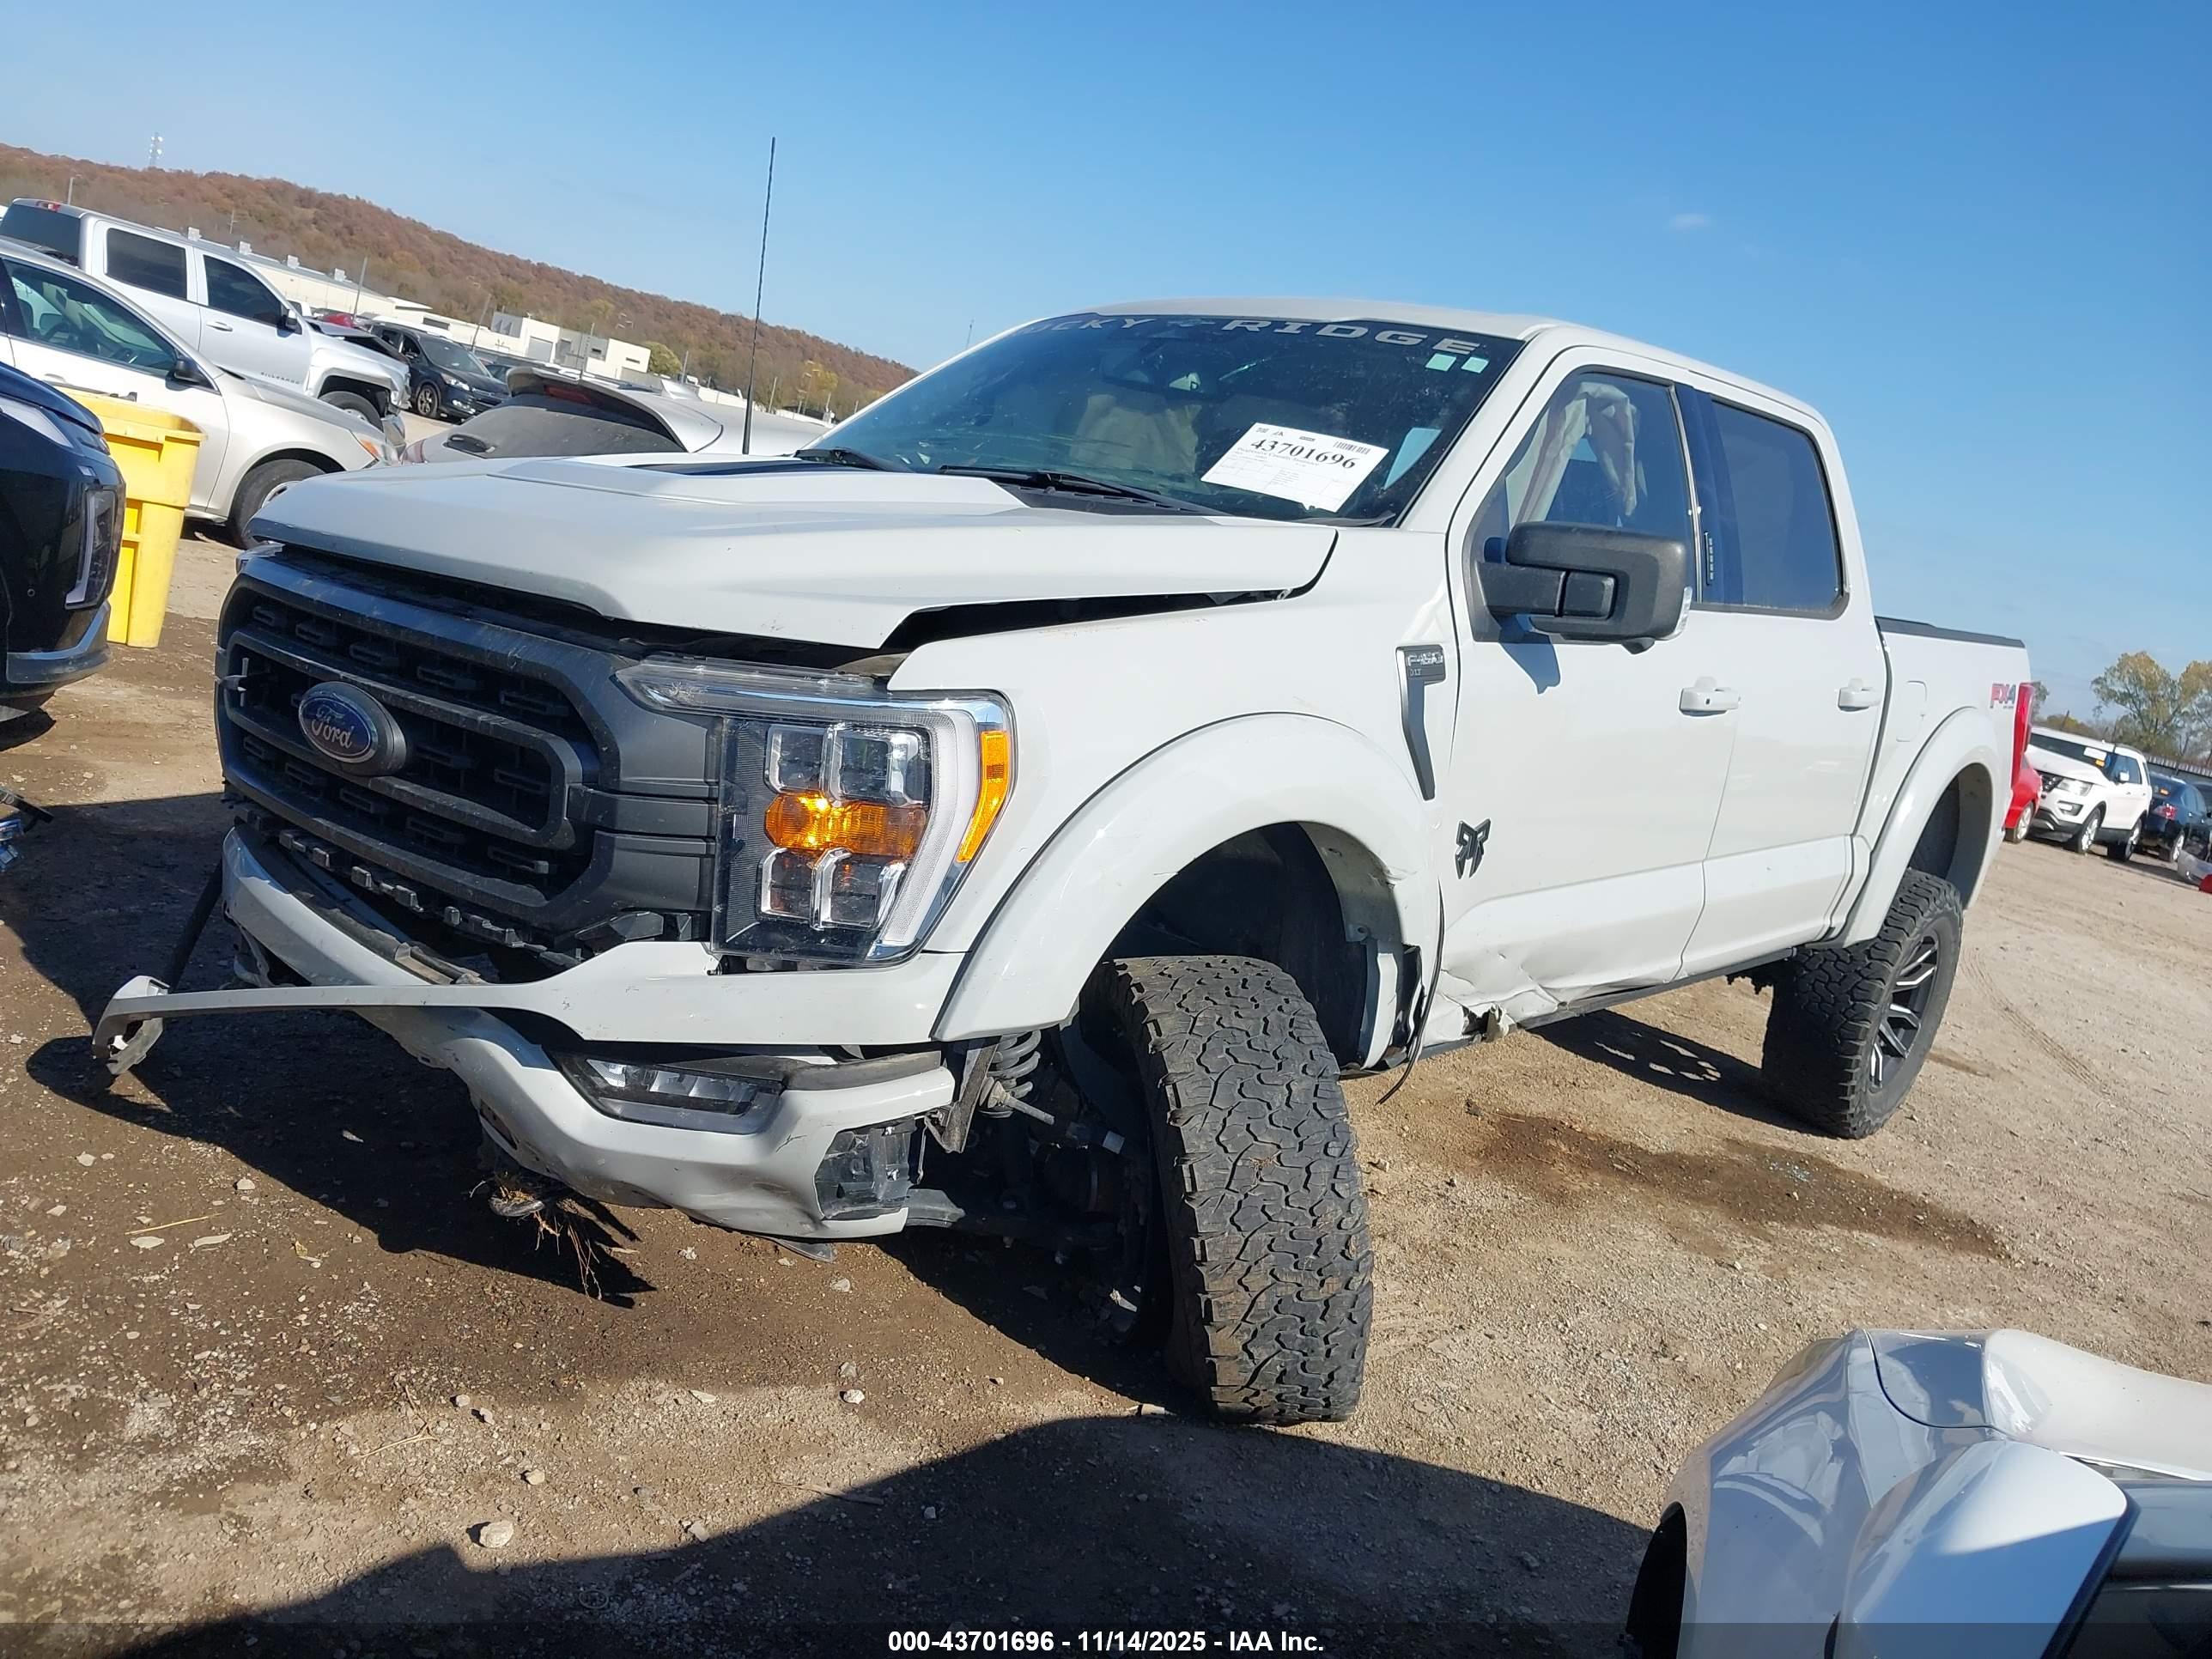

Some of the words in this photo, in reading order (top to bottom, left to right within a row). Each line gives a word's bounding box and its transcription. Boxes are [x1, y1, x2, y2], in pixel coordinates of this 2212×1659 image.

[1221, 319, 1480, 355] RIDGE
[1251, 439, 1360, 469] 43701696
[1990, 684, 2016, 708] FX4
[311, 704, 356, 749] Ford
